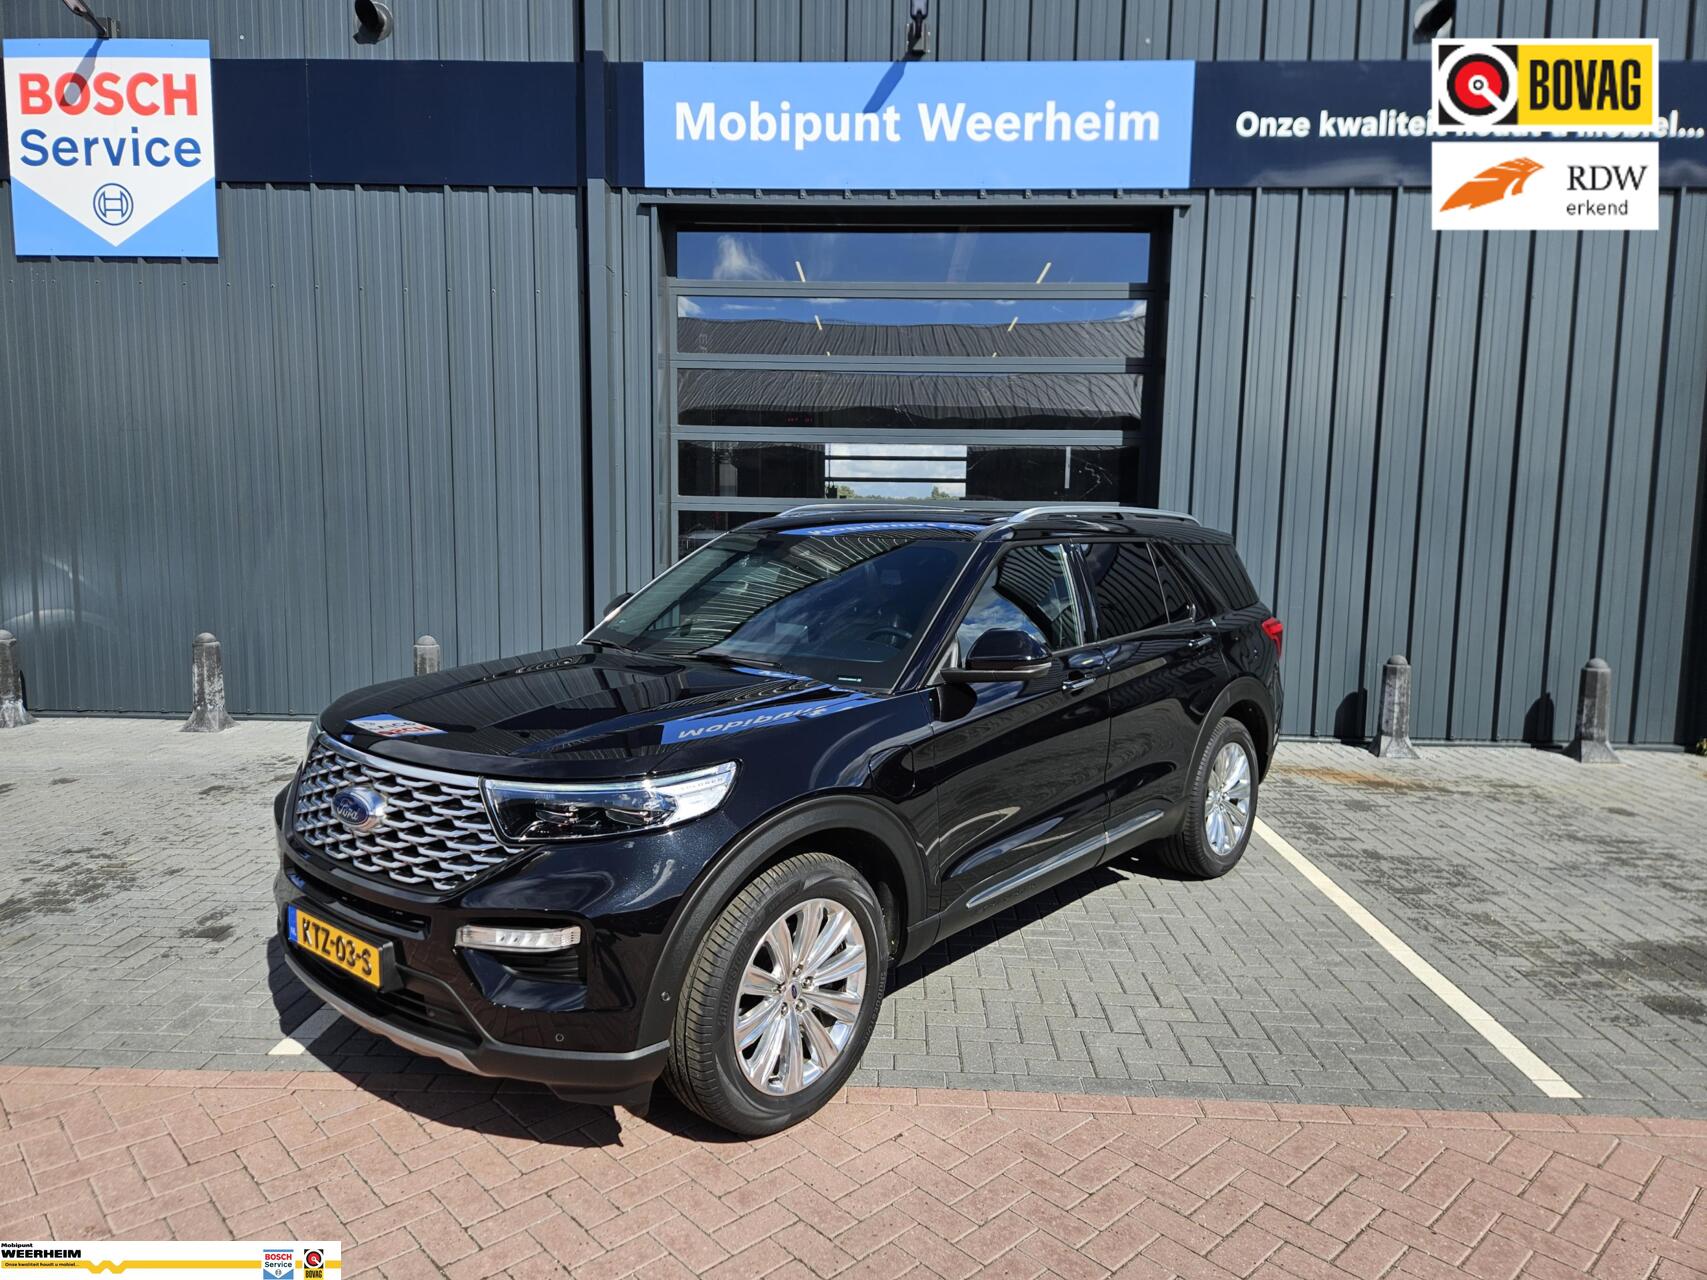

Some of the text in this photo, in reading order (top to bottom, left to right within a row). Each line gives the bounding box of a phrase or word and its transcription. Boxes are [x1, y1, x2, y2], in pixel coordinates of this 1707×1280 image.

[18, 72, 198, 116] BOSCH
[674, 99, 1160, 151] Mobipunt Weerheim
[1235, 110, 1311, 138] Onze
[1319, 109, 1447, 138] kwalitei
[19, 126, 202, 168] Service
[302, 917, 372, 976] KTZ-03-S
